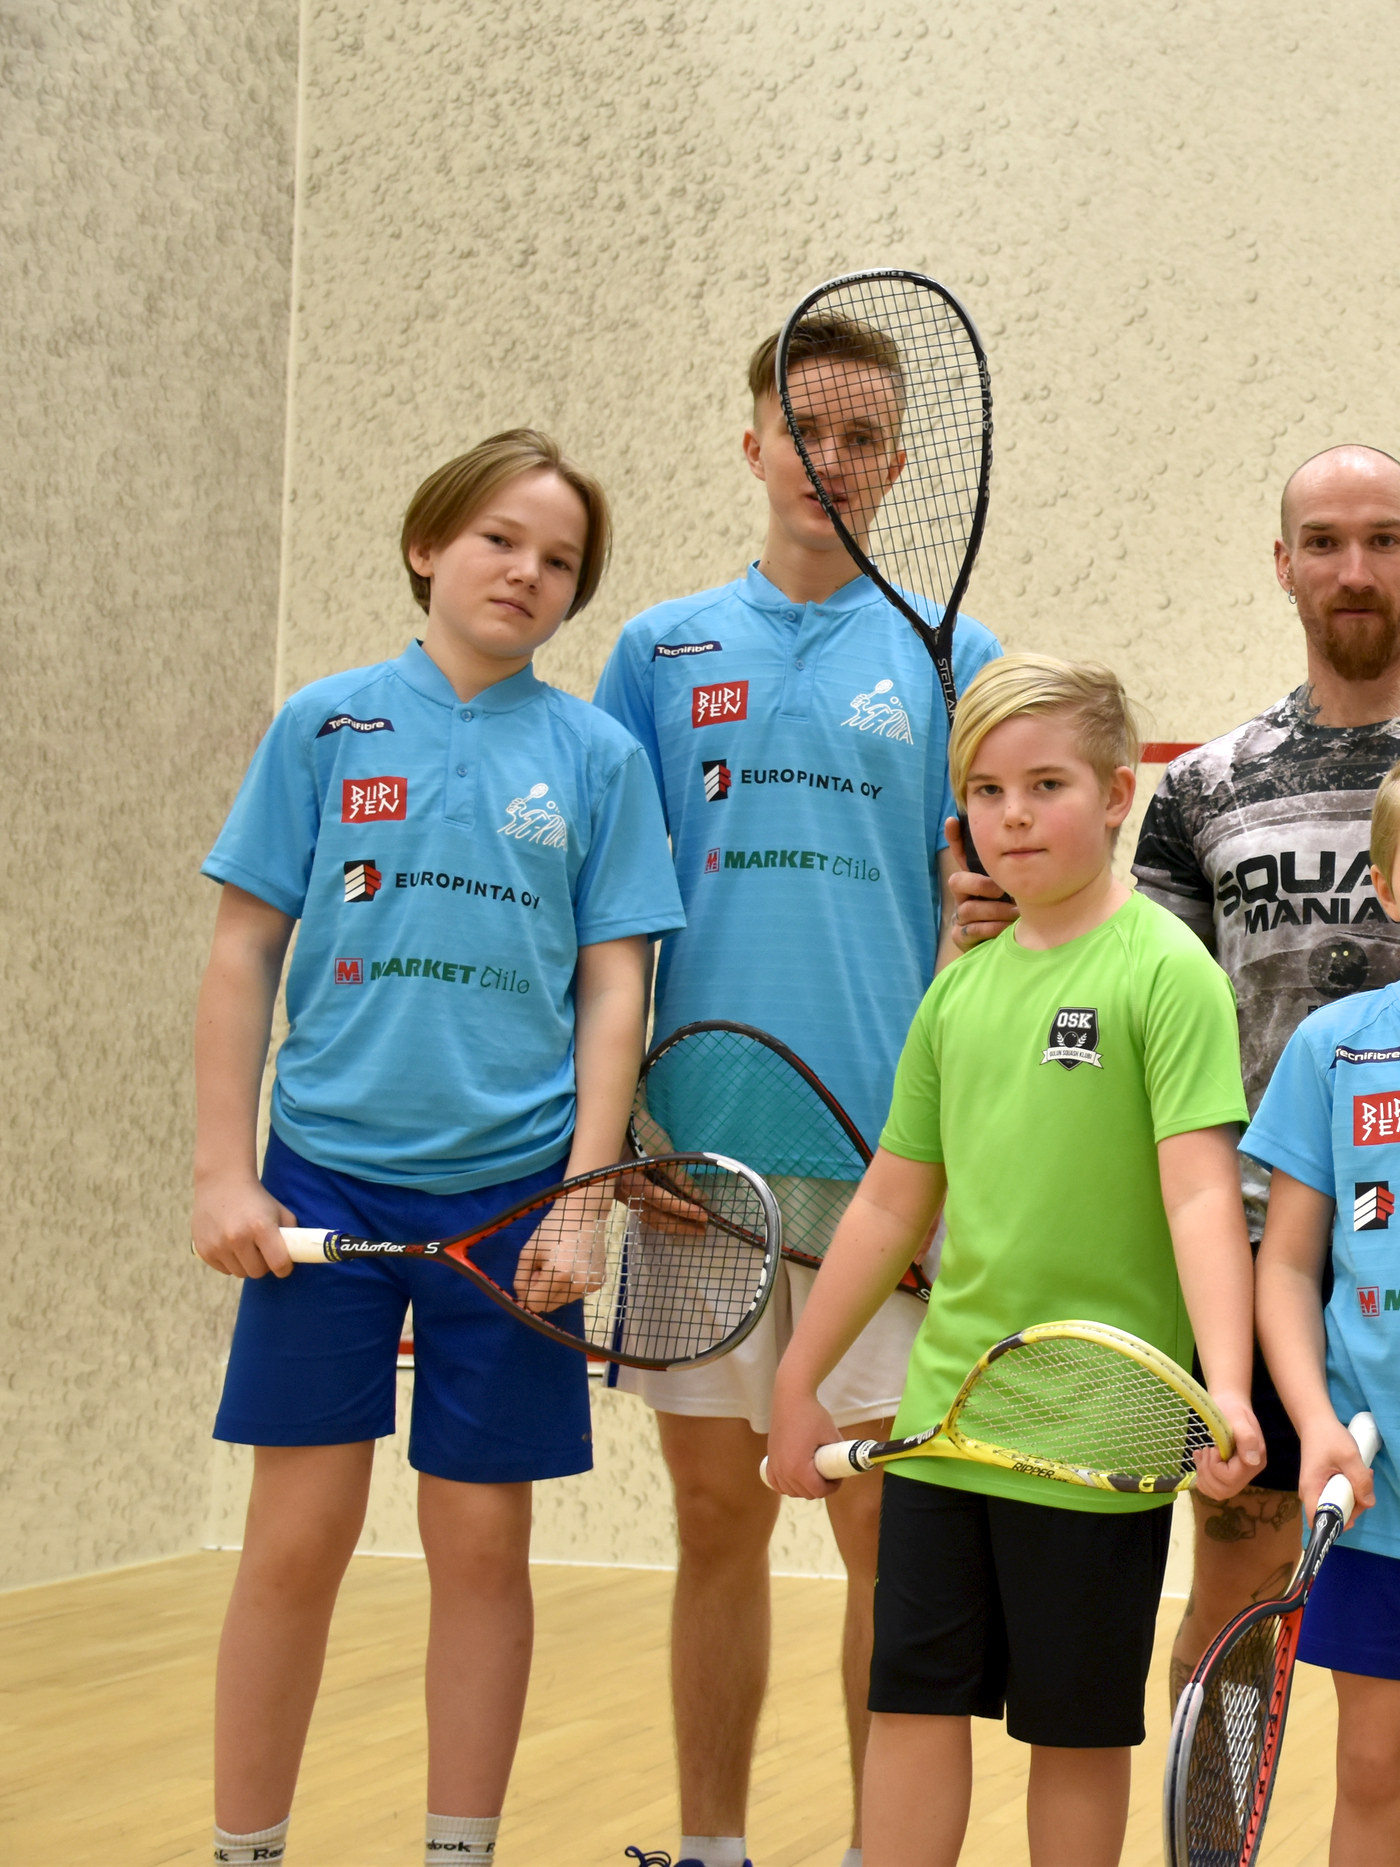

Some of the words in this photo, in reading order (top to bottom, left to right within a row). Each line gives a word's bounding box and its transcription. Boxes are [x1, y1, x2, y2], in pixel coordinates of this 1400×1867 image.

[657, 643, 714, 656] Tecnifibre
[328, 717, 385, 731] Tecnifibre
[741, 768, 854, 794] EUROPINTA
[860, 781, 883, 800] OY
[724, 849, 829, 872] MARKET
[395, 871, 516, 903] EUROPINTA
[521, 891, 540, 909] OY
[1217, 850, 1373, 917] SQUA
[370, 957, 477, 985] MARKET
[1056, 1011, 1094, 1029] OSK
[1336, 1048, 1400, 1061] Tecnifibre
[340, 1238, 406, 1254] arboflex
[1011, 1462, 1055, 1479] RIPPER
